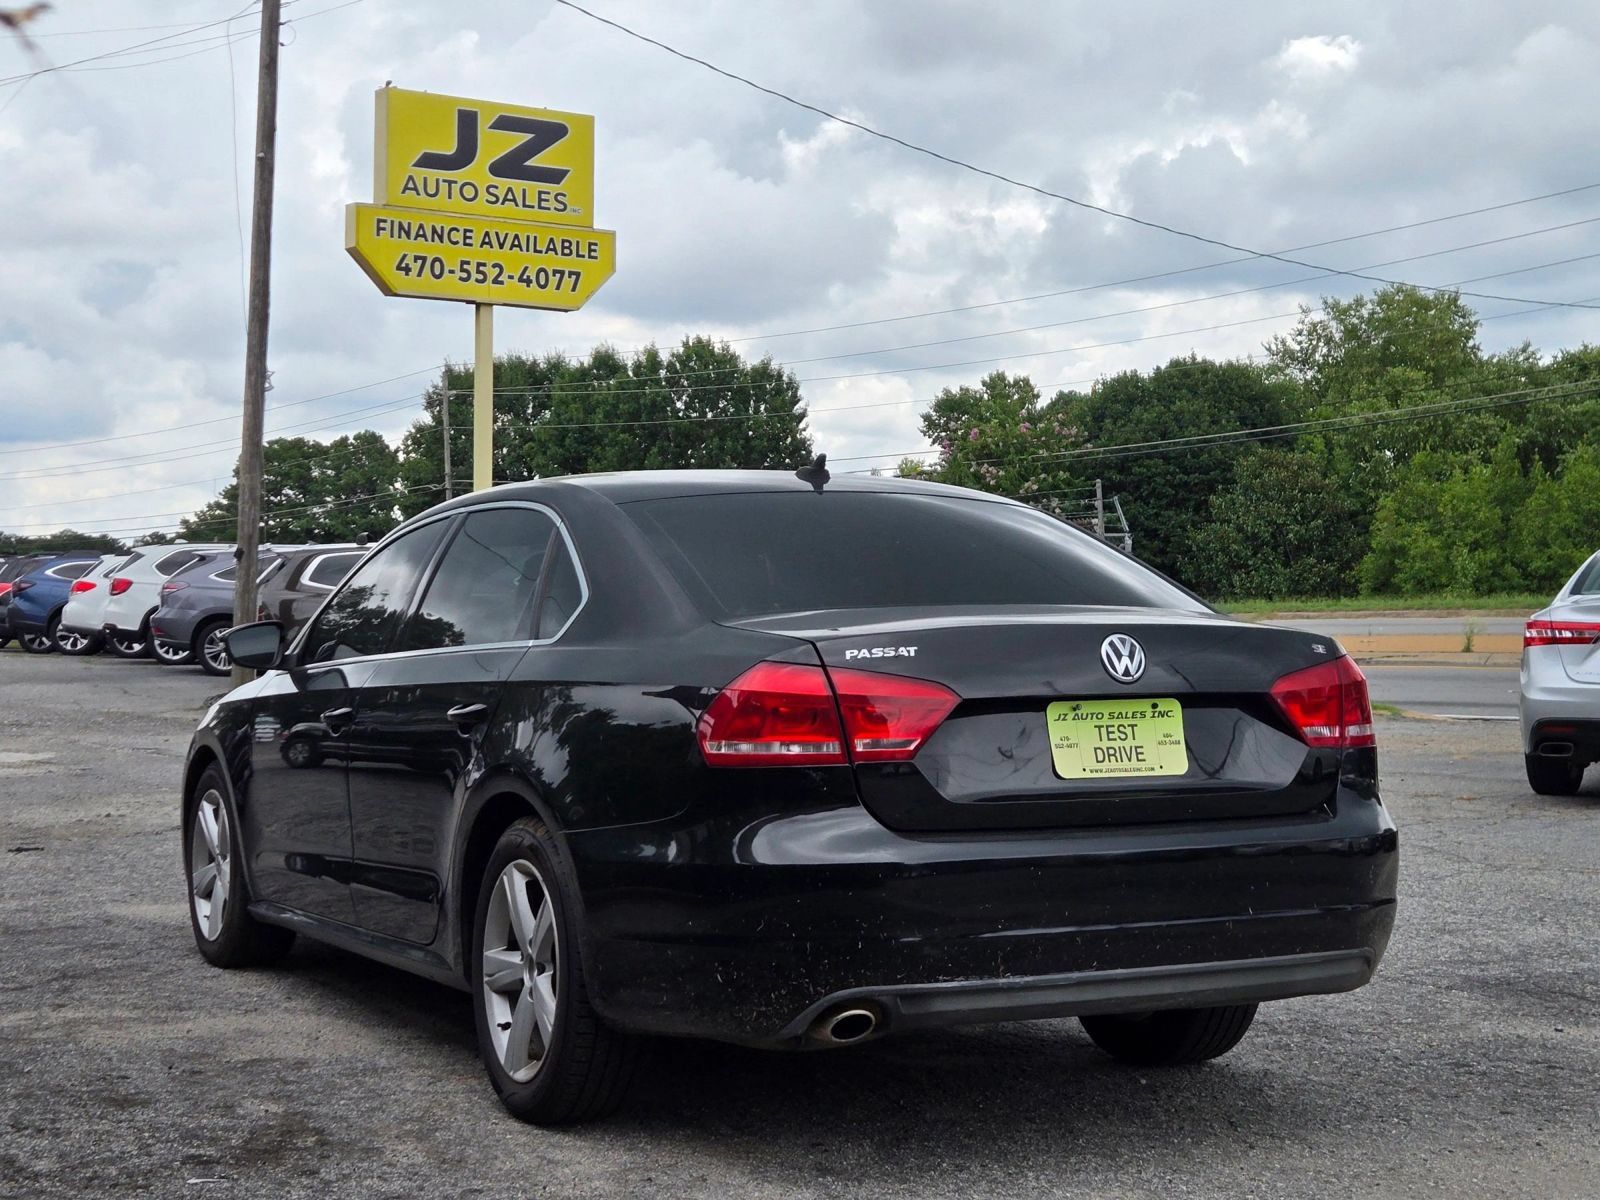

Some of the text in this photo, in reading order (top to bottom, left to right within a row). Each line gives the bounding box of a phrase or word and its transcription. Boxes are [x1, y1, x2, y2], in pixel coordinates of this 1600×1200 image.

[411, 107, 573, 186] JZ
[401, 174, 480, 203] AUTO
[485, 183, 569, 213] SALES
[375, 218, 600, 261] FINANCE AVAILABLE
[395, 252, 582, 294] 470-552-4077
[845, 646, 918, 660] PASSAT
[1053, 709, 1175, 722] JZ AUTO SALES INC.
[1094, 723, 1138, 742] TEST
[1093, 745, 1146, 764] DRIVE
